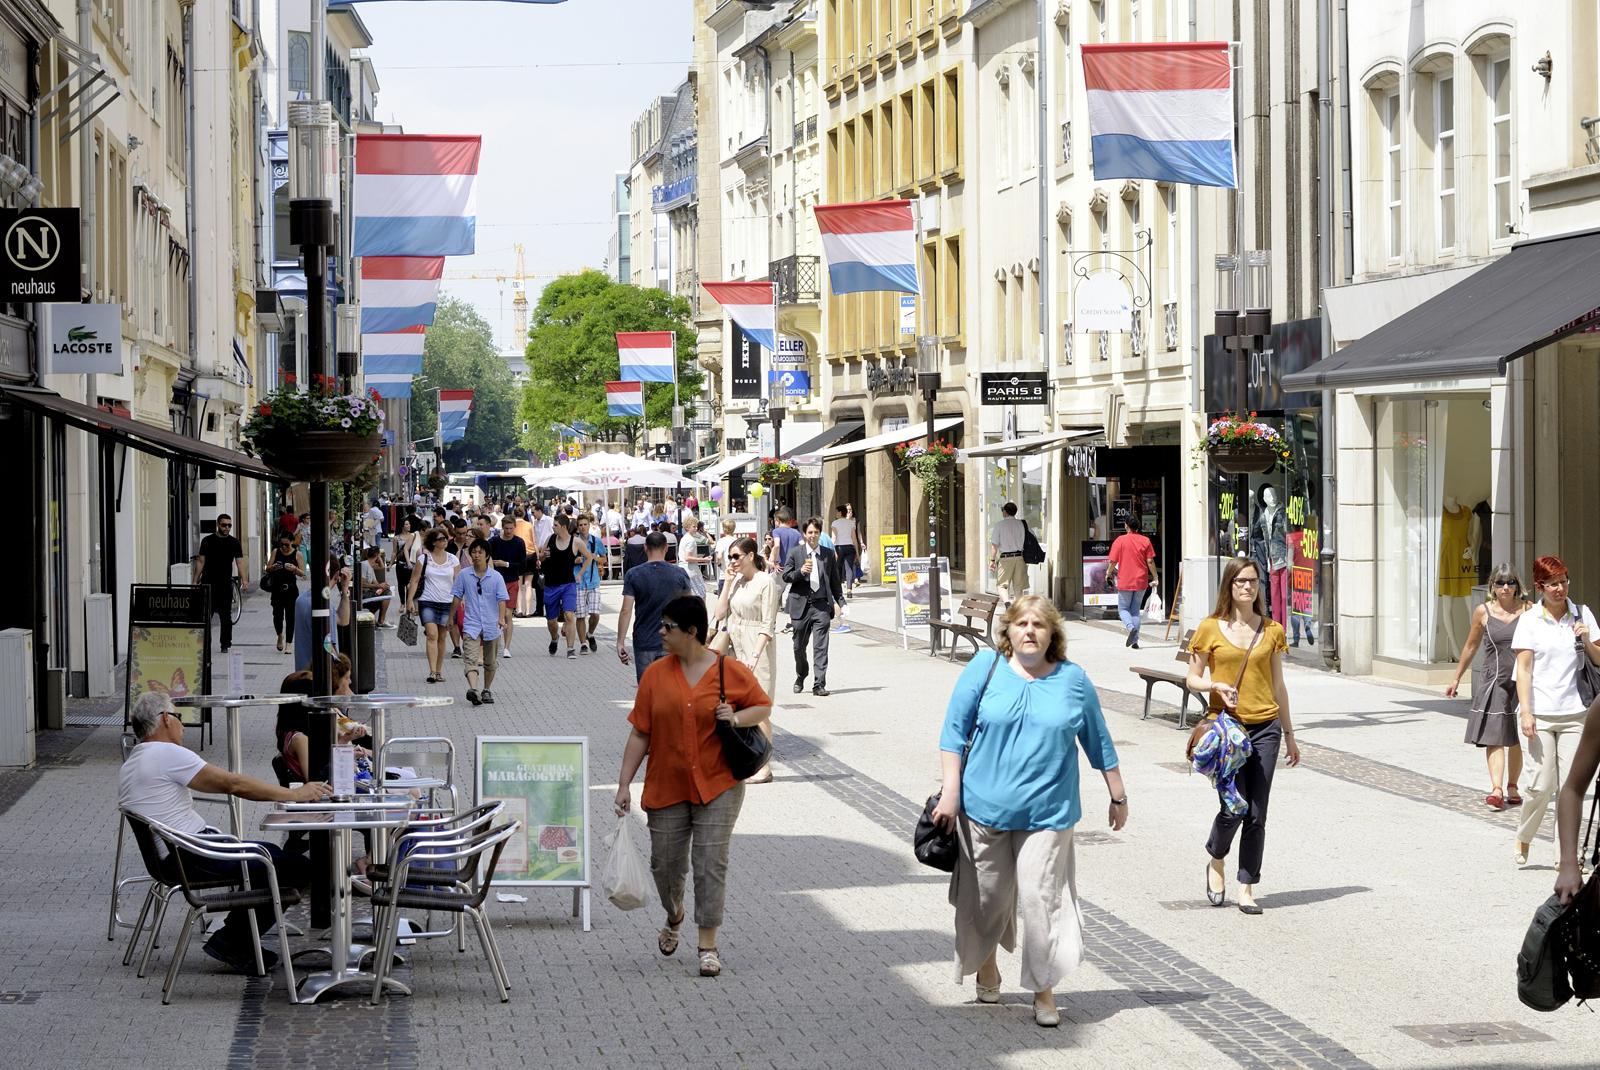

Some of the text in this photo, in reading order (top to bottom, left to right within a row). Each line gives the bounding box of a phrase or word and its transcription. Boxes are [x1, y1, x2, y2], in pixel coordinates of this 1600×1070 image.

[16, 227, 50, 259] N
[11, 278, 56, 295] neuhaus
[53, 343, 113, 354] LACOSTE
[777, 340, 804, 351] ELLER
[1248, 349, 1274, 388] OFT
[987, 387, 1043, 395] PARIS 8
[1286, 496, 1304, 525] -40%
[1300, 528, 1318, 560] -50%
[1293, 570, 1312, 591] VENTE
[149, 593, 190, 609] neuhaus
[487, 771, 573, 781] MARAGOGYPE
